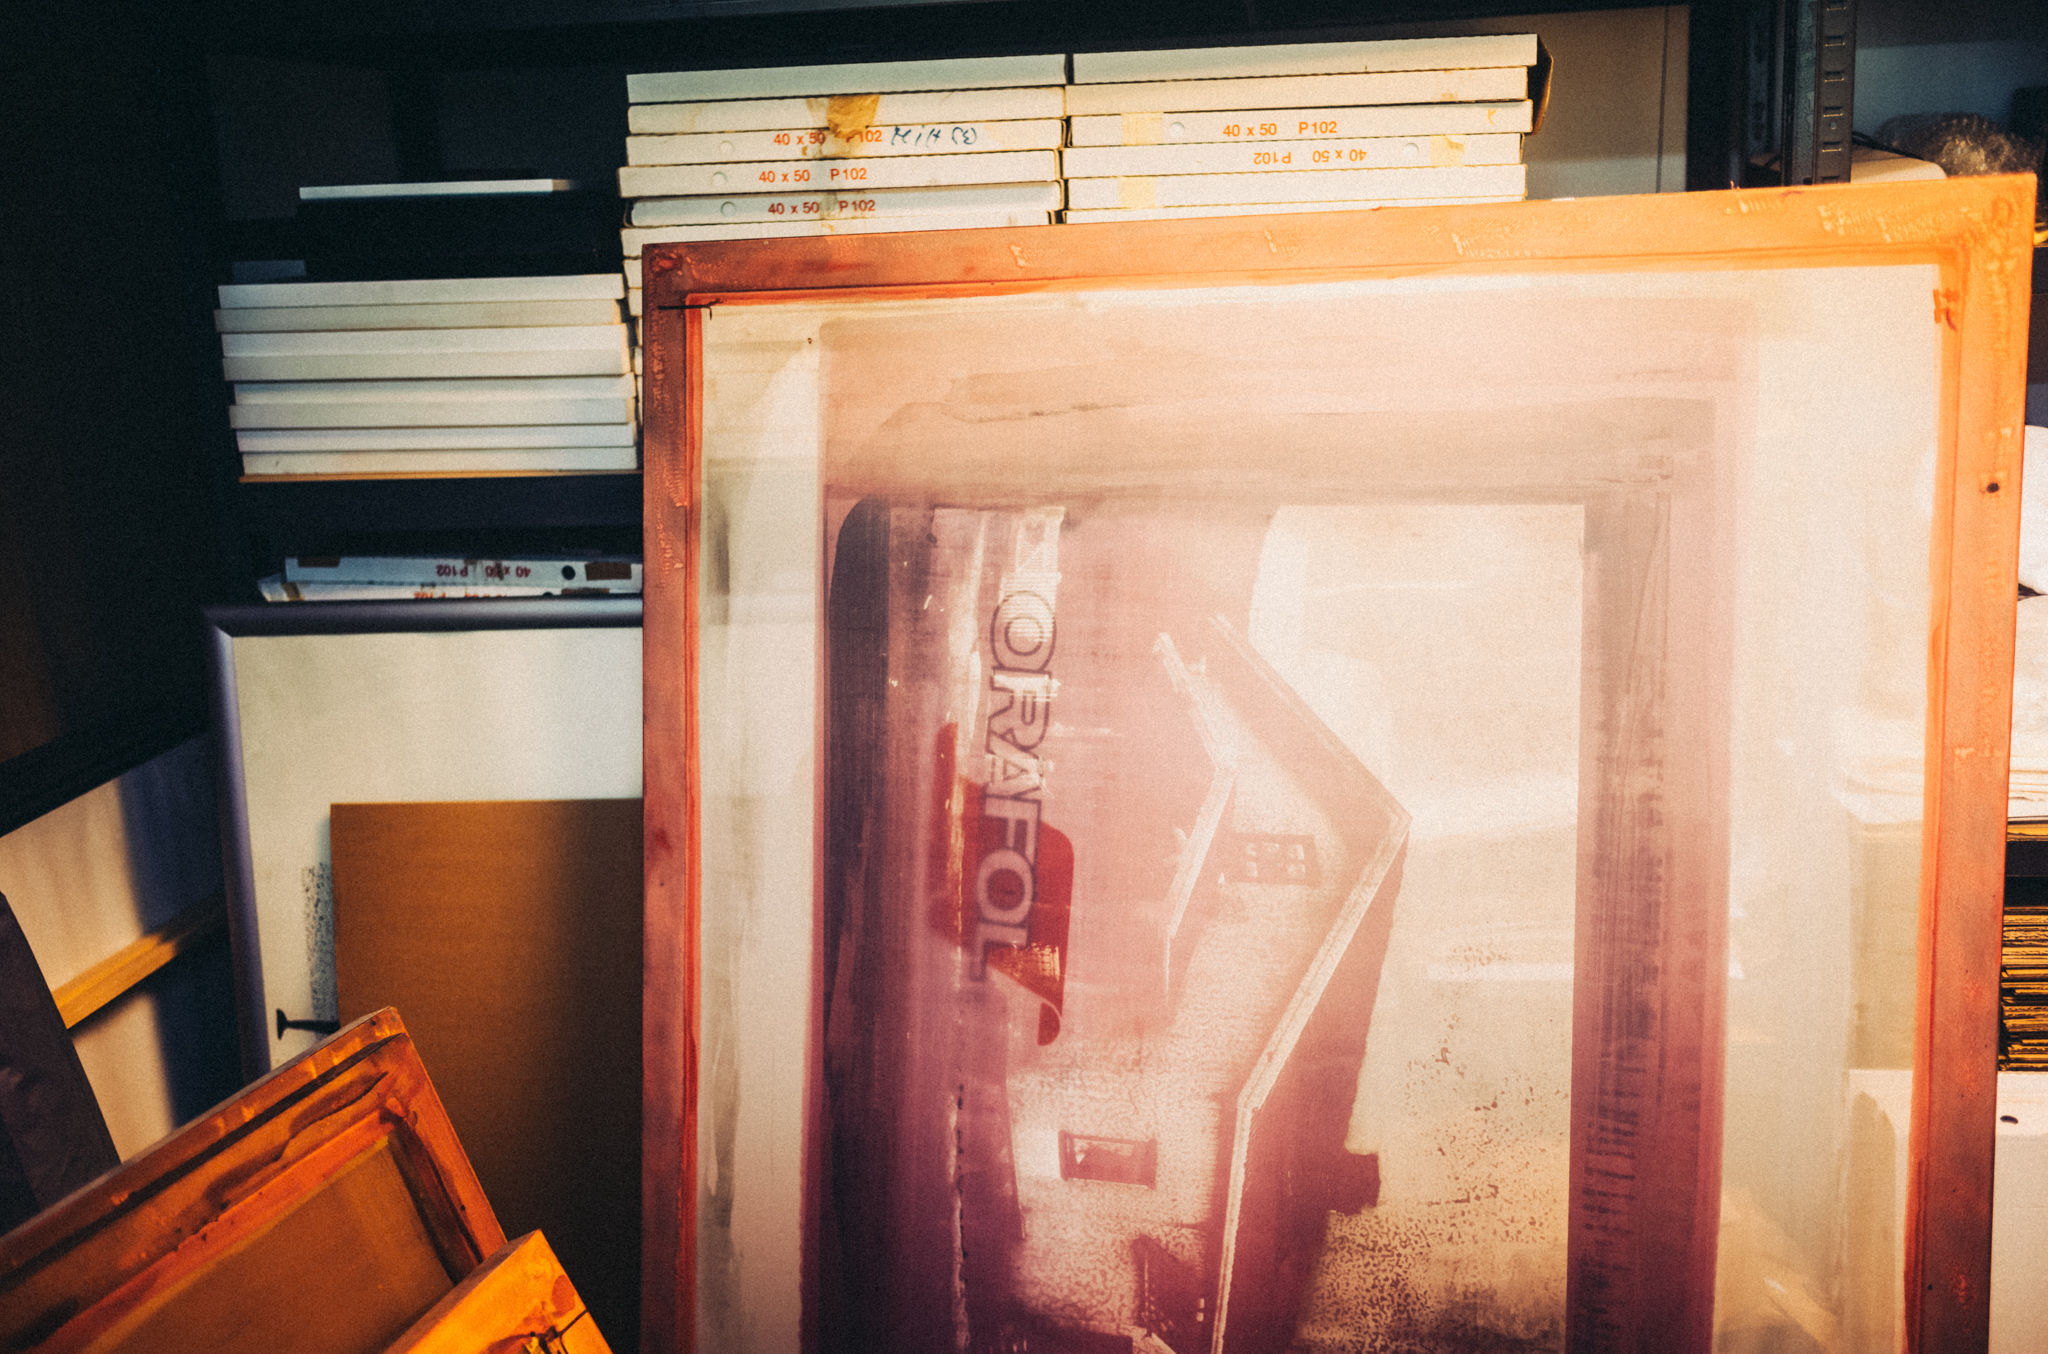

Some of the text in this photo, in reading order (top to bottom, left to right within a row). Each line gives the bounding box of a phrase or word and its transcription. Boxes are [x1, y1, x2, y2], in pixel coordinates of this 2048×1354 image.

[1222, 124, 1241, 137] 40
[1246, 127, 1255, 137] x
[1259, 123, 1278, 136] 50
[773, 133, 791, 146] 40
[796, 136, 805, 145] x
[808, 131, 826, 145] 50
[1312, 150, 1330, 163] 50
[1335, 150, 1343, 160] x
[1349, 149, 1367, 162] 40
[758, 170, 776, 183] 40
[781, 173, 790, 183] x
[793, 169, 811, 182] 50
[768, 202, 785, 215] 40
[790, 205, 799, 214] x
[802, 201, 820, 214] 50
[515, 565, 532, 578] 40
[970, 590, 1057, 984] ORAFOL
